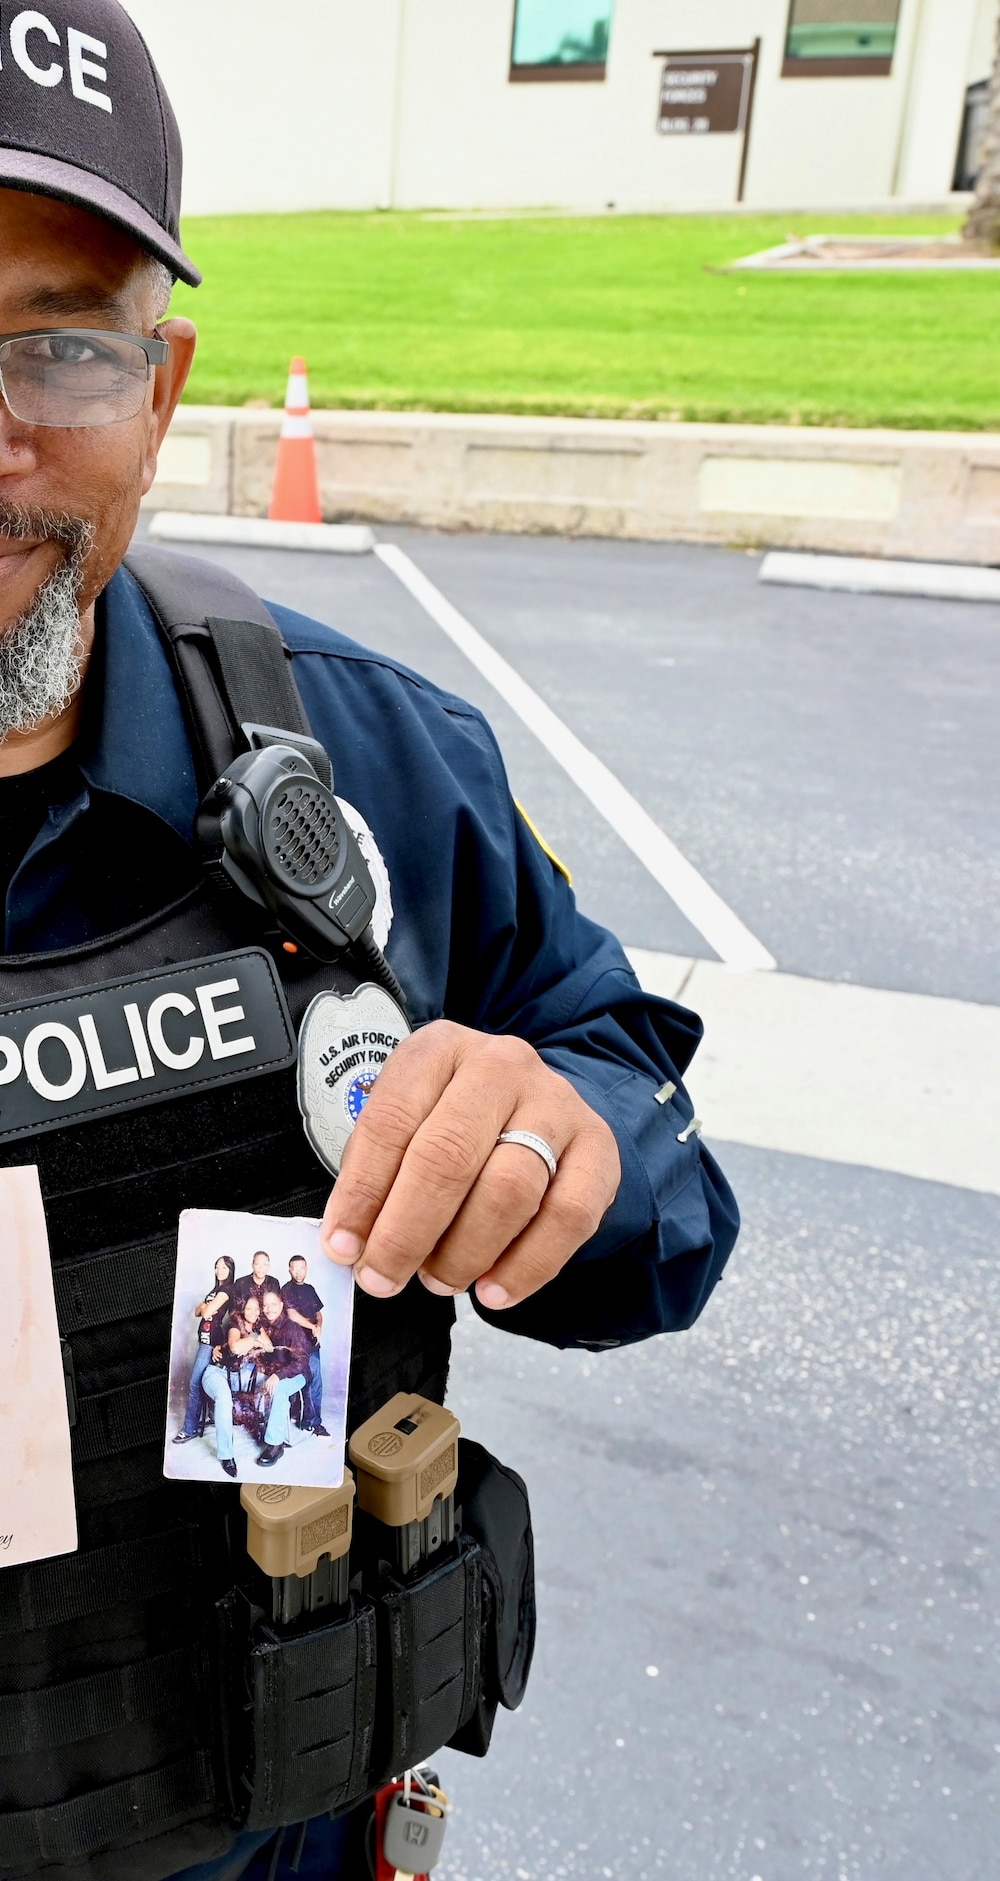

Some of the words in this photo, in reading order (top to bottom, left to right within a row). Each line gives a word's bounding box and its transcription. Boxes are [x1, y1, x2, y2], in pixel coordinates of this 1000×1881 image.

[319, 1045, 341, 1067] U.S.
[342, 1034, 360, 1051] AIR
[362, 1032, 400, 1049] FORCE
[325, 1051, 366, 1088] SECURITY
[368, 1050, 388, 1063] FOR
